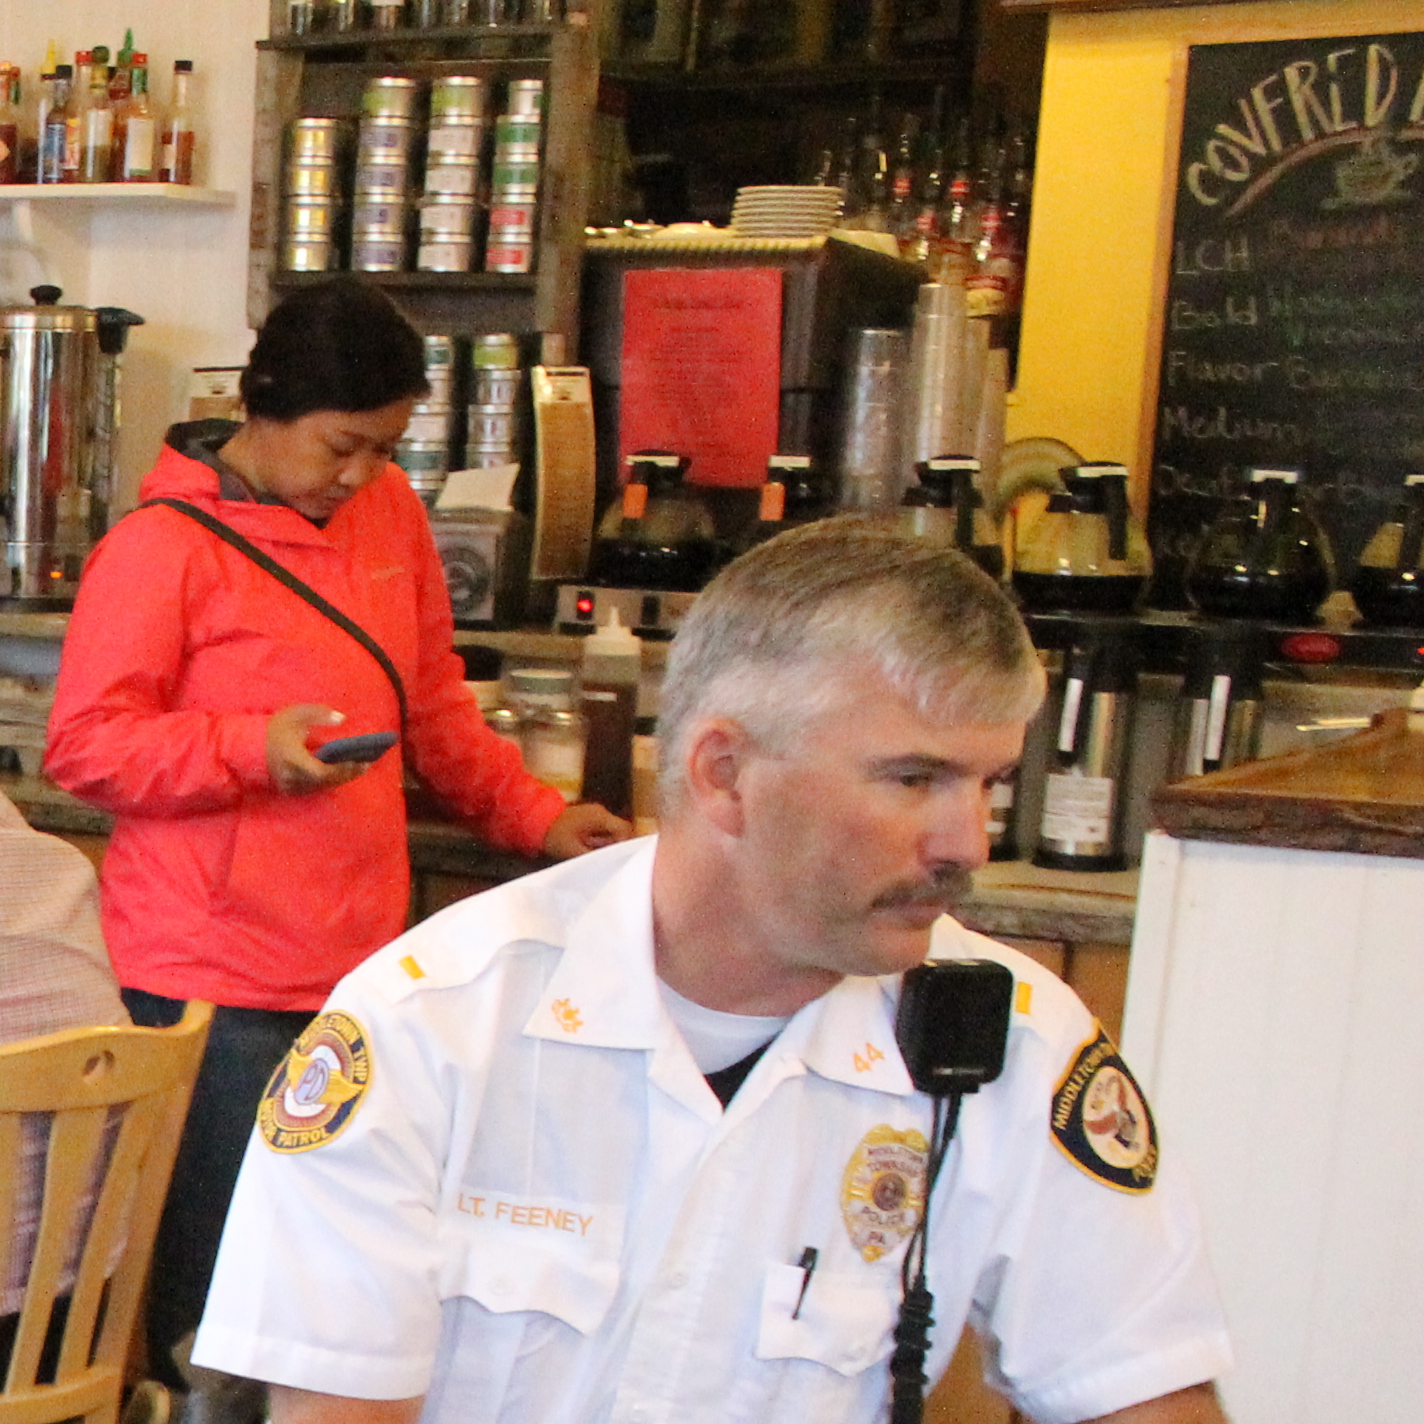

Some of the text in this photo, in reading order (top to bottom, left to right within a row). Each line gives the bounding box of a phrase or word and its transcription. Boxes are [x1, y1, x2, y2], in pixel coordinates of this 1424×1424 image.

[853, 1042, 885, 1073] 44
[275, 1128, 332, 1149] PATROL
[494, 1201, 594, 1237] FEENEY
